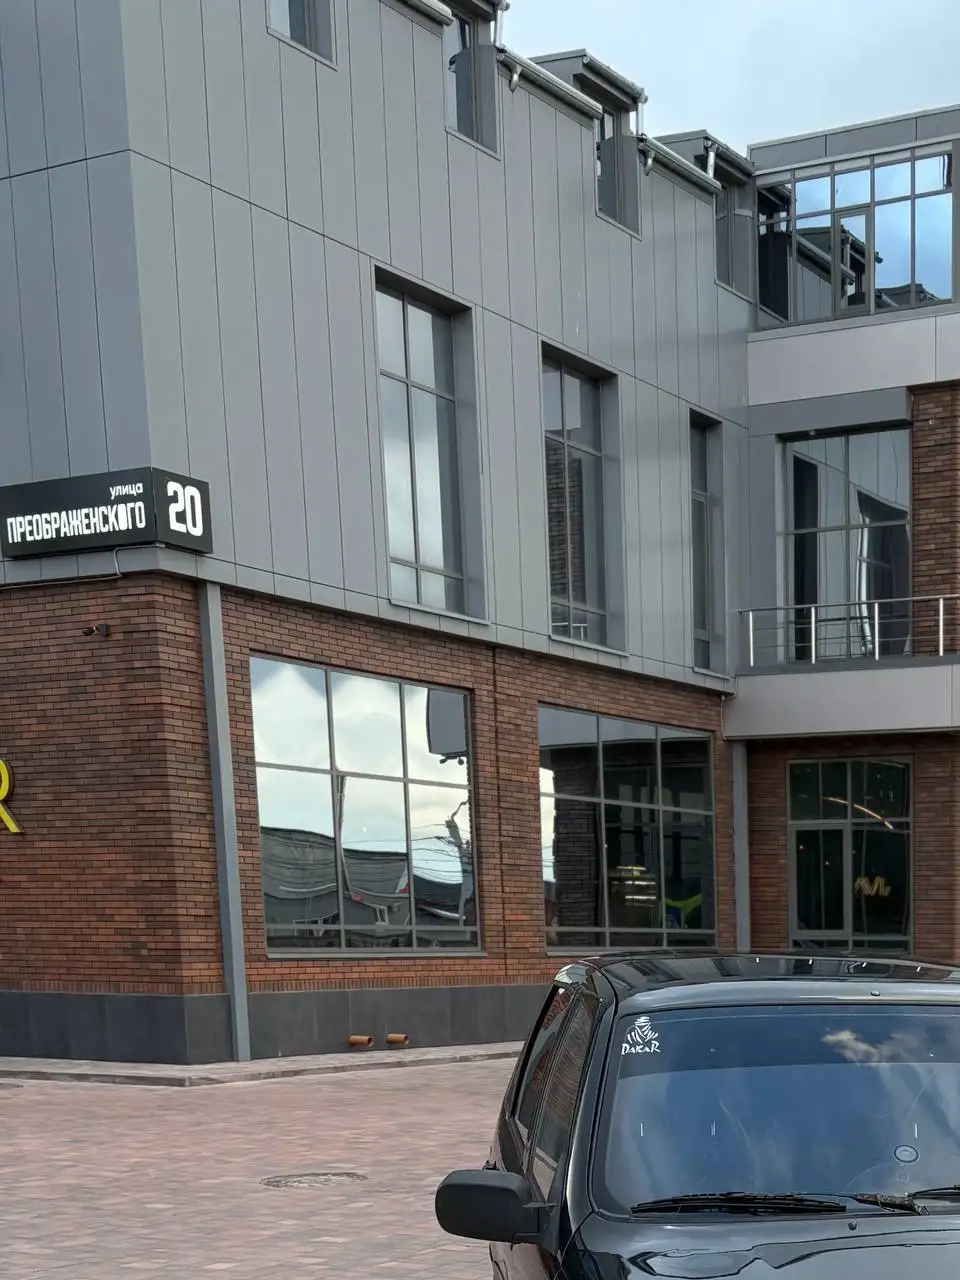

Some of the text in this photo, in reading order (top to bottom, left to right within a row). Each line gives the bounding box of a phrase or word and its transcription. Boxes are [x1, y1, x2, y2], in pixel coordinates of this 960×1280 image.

[109, 482, 144, 500] улица
[6, 501, 147, 544] ПРЕОБРАЖЕНСКОГО
[167, 480, 204, 537] 20
[621, 1040, 661, 1056] DAKAR
